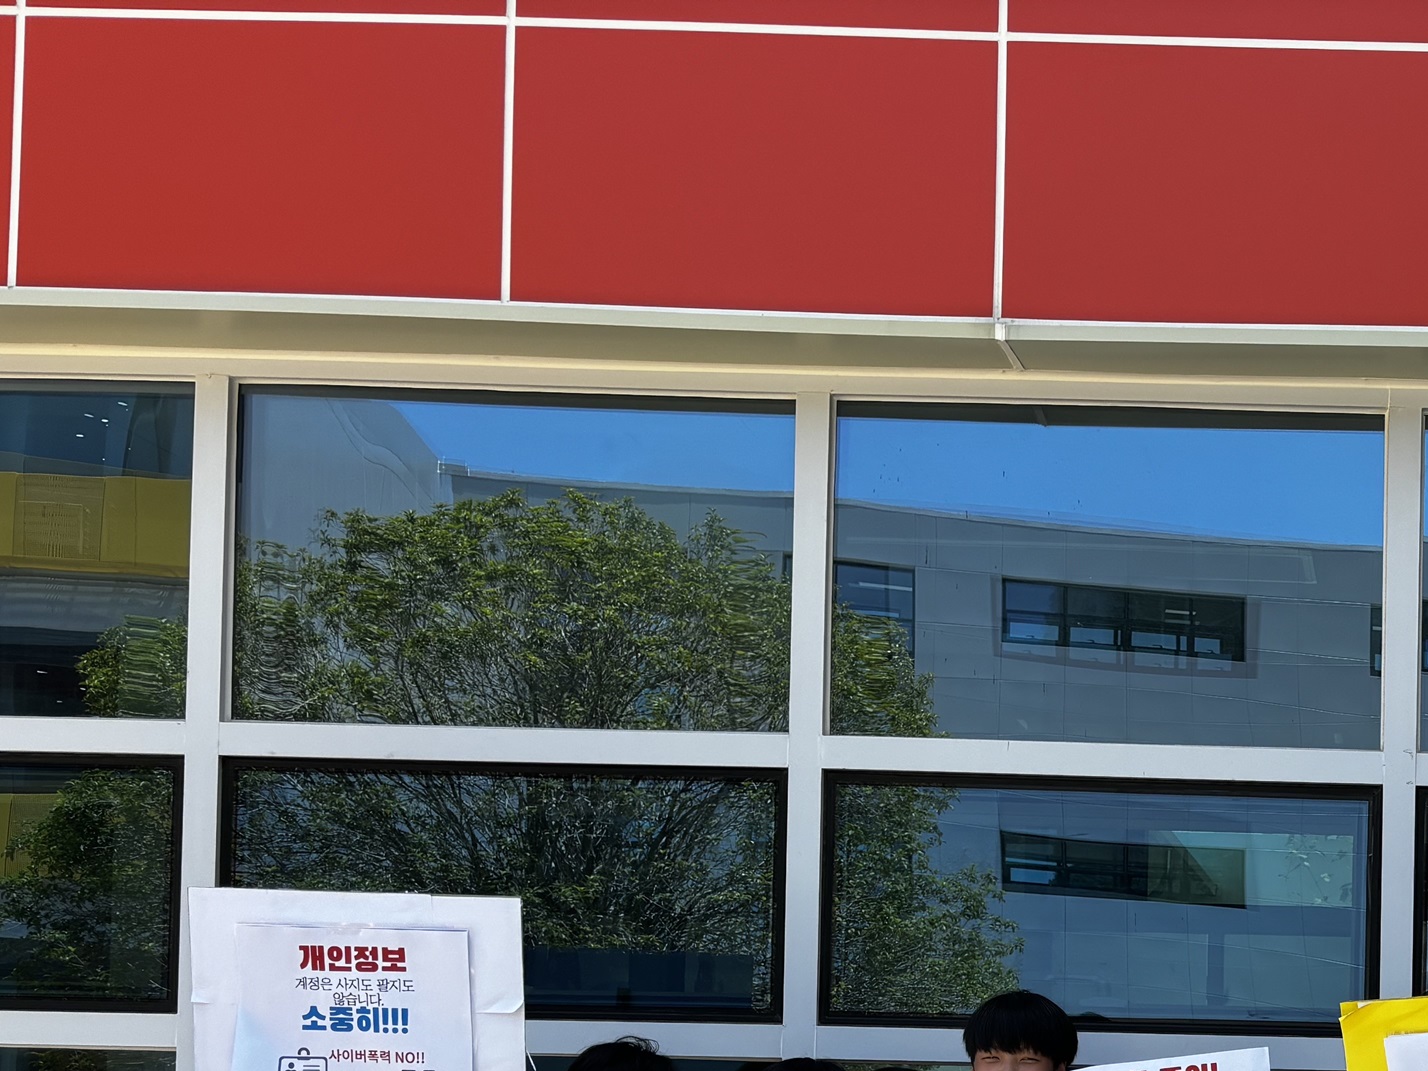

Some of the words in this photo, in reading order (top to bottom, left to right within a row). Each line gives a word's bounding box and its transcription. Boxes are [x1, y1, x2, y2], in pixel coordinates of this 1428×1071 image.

[299, 945, 407, 973] 개인정보
[295, 976, 333, 991] 계정은
[336, 977, 374, 992] 사지도
[376, 978, 415, 993] 팔지도
[332, 992, 384, 1007] 않습니다.
[301, 1005, 409, 1034] 소중히!!!
[328, 1048, 391, 1064] 사이버폭력
[394, 1051, 425, 1065] NO!!
